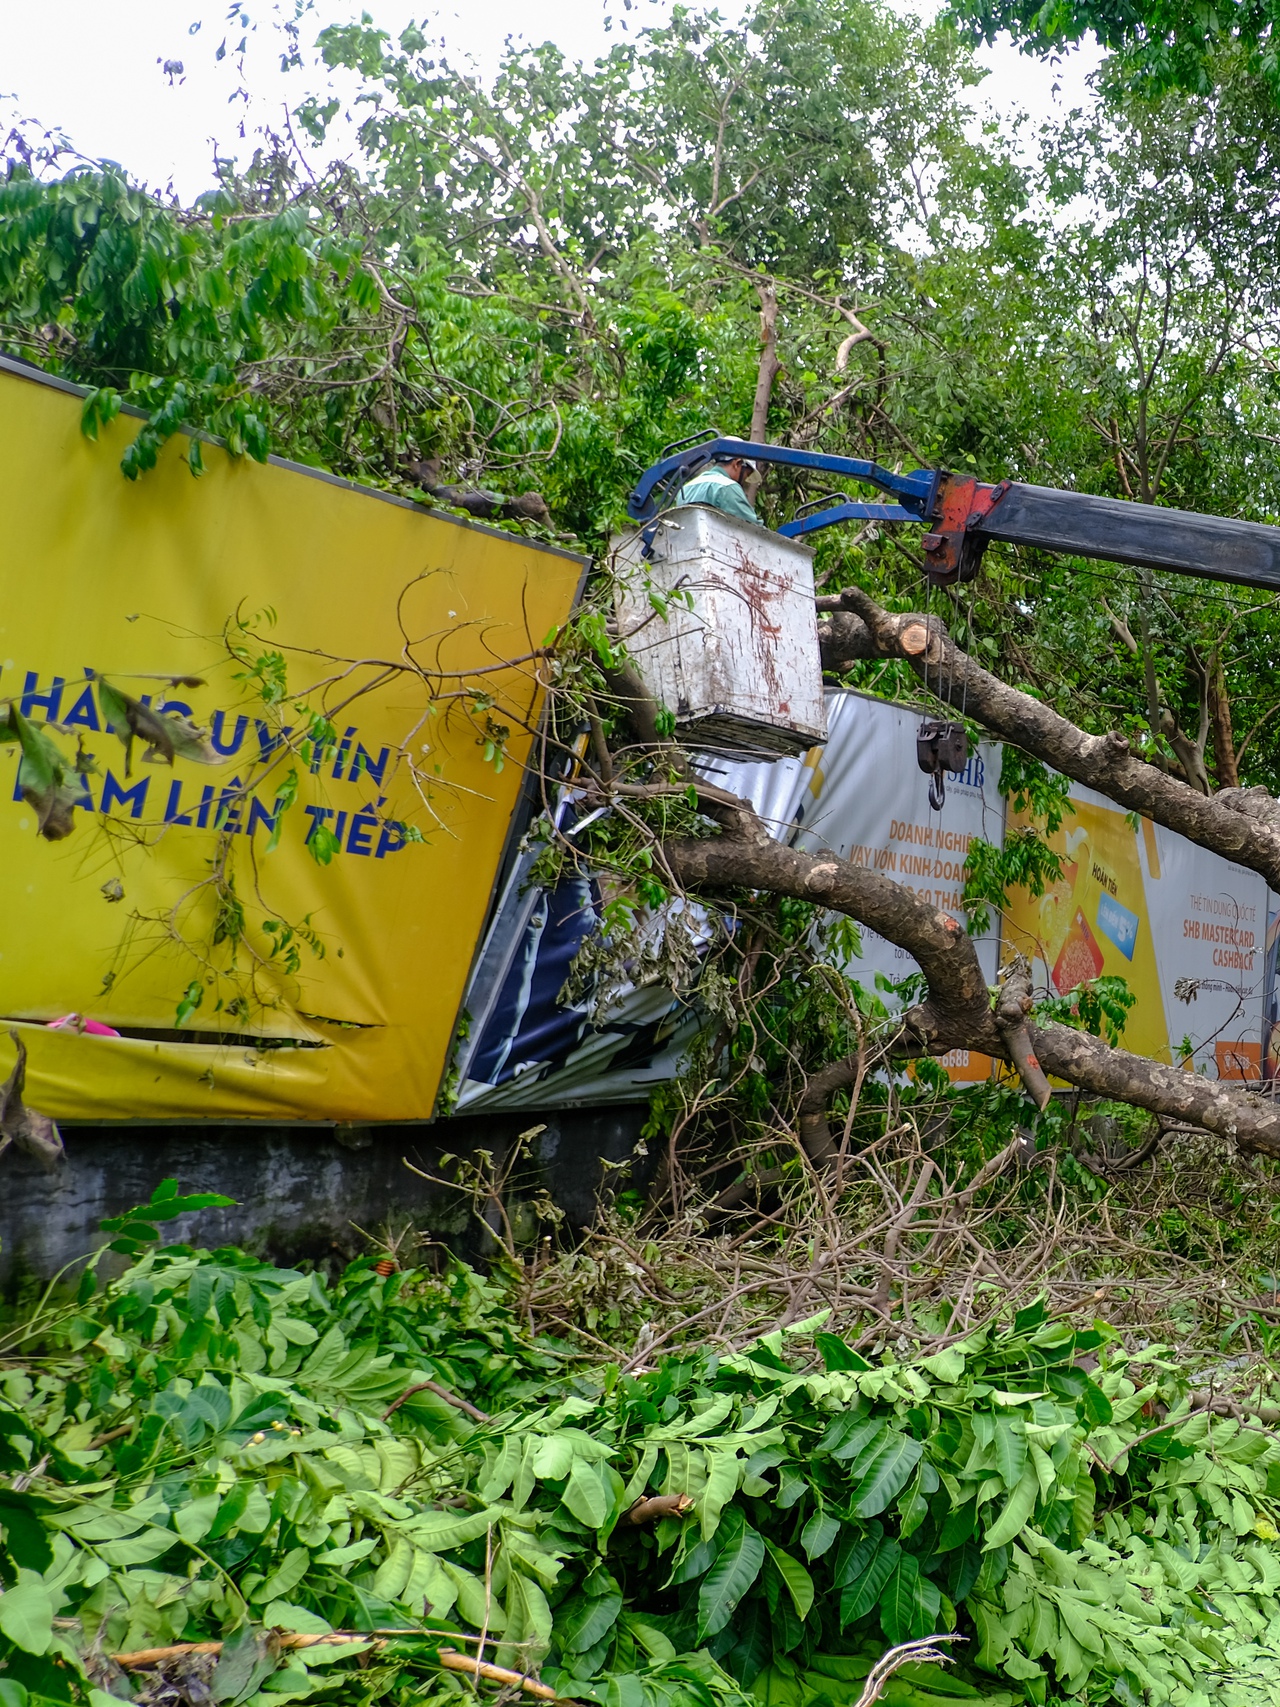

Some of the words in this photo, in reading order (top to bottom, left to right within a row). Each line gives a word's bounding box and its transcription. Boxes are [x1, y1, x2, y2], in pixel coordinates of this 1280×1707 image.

[211, 709, 294, 764] UY
[308, 726, 391, 788] TÍN
[163, 775, 287, 836] LIÊN
[304, 796, 409, 859] TIẾP
[889, 819, 933, 846] DOANH
[850, 844, 873, 868] VAY
[874, 844, 897, 872] VỐN
[900, 853, 931, 877] KINH
[1183, 919, 1200, 939] SHB
[1201, 922, 1255, 949] MASTERCARD
[1212, 948, 1254, 971] CASHBACK
